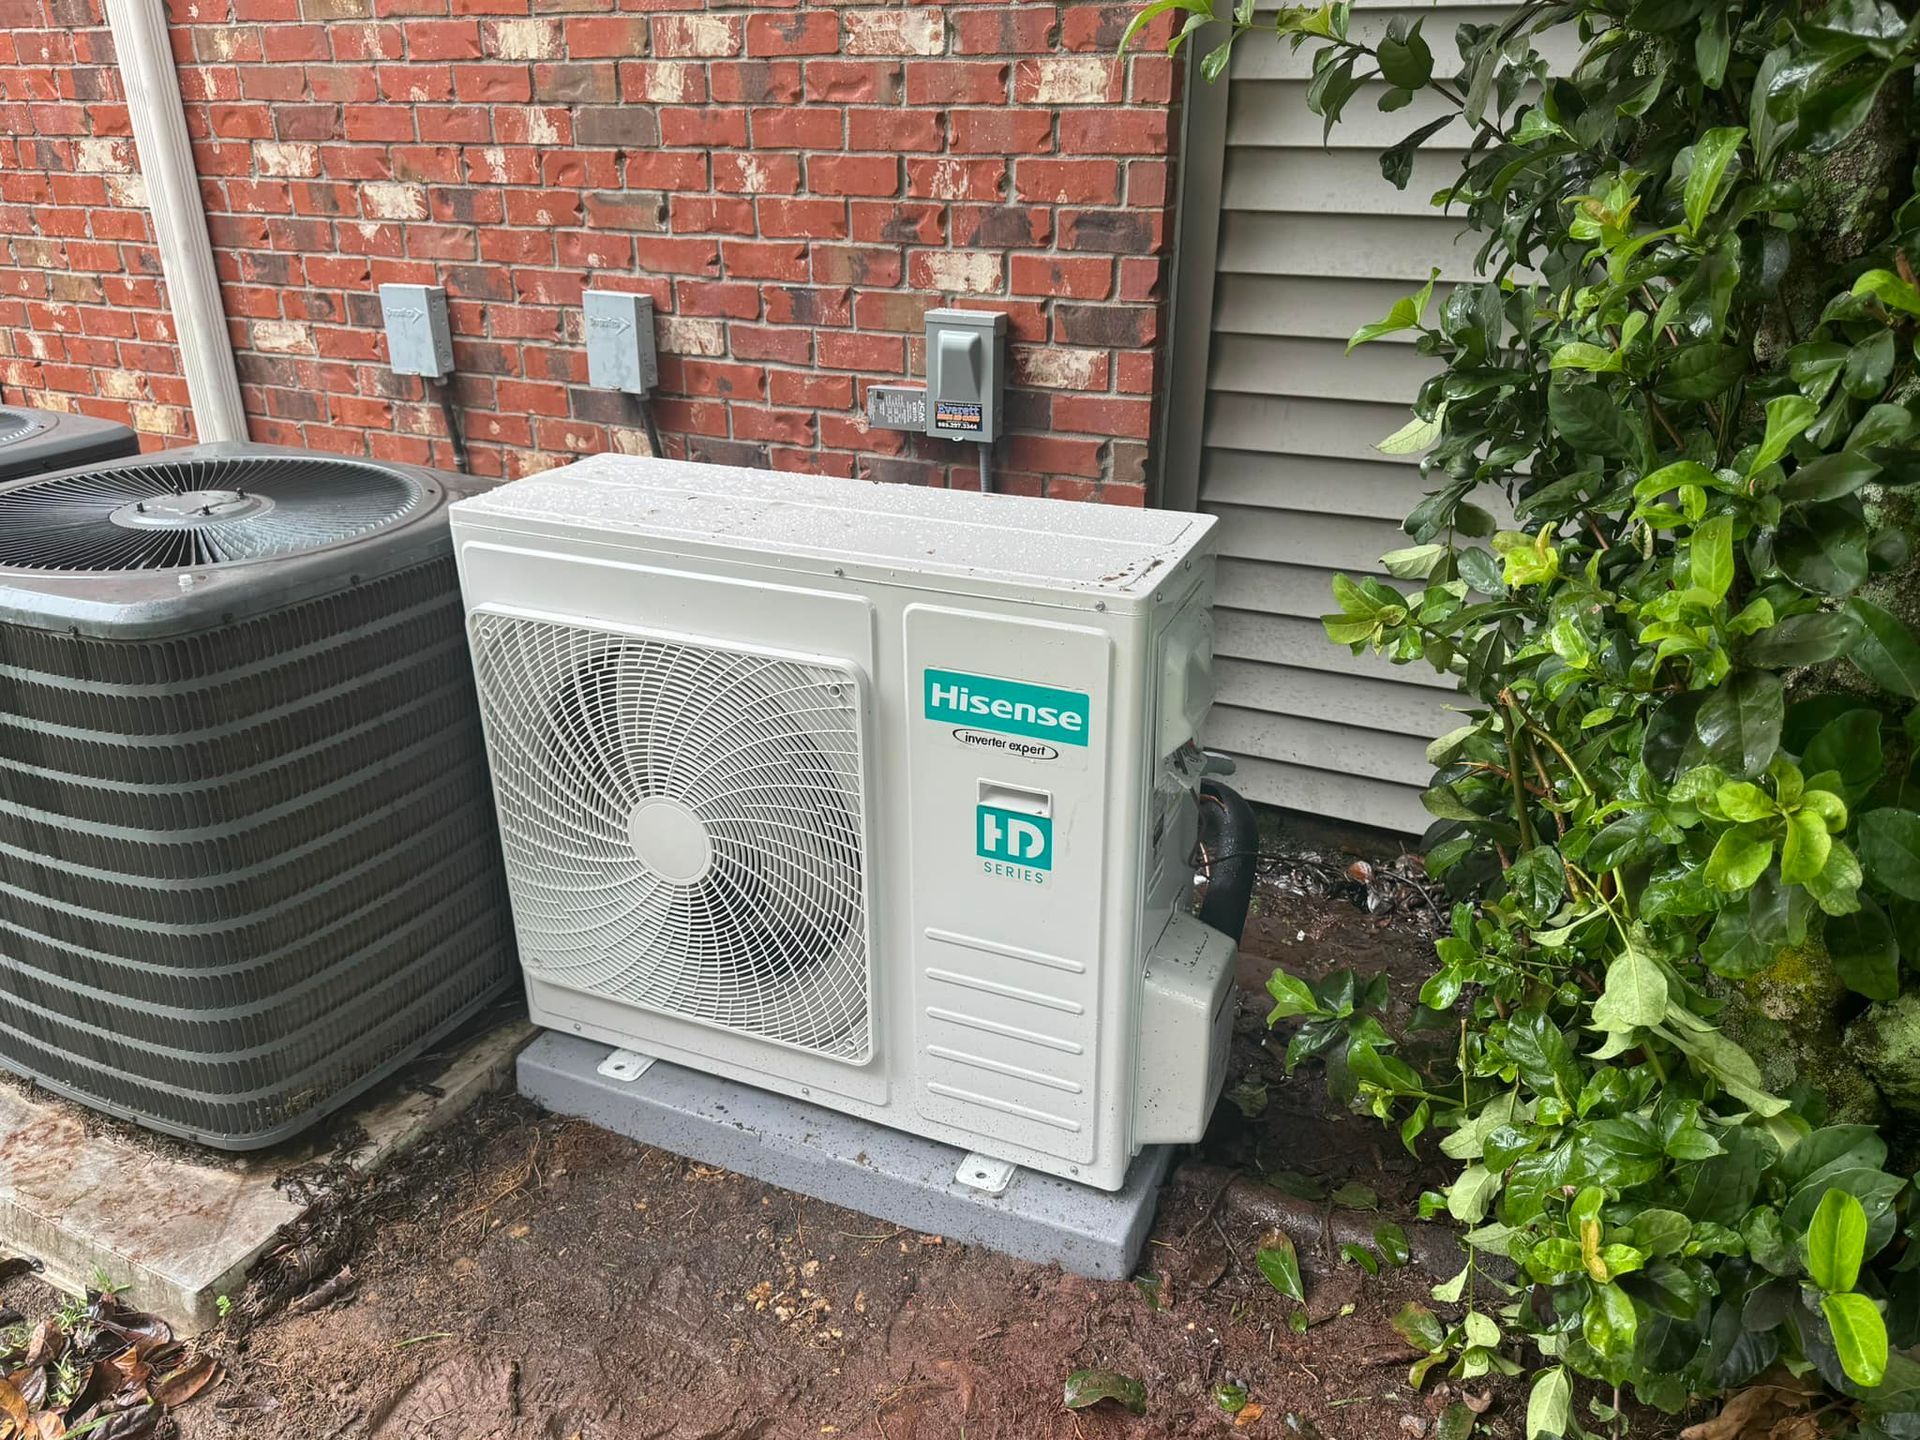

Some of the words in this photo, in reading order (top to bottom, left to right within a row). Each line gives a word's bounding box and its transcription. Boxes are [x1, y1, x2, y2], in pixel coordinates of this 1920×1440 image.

[931, 682, 1082, 731] Hisense
[965, 732, 1007, 749] inverter
[1008, 742, 1046, 757] expert
[983, 813, 1045, 858] HD
[984, 861, 1043, 884] SERIES
